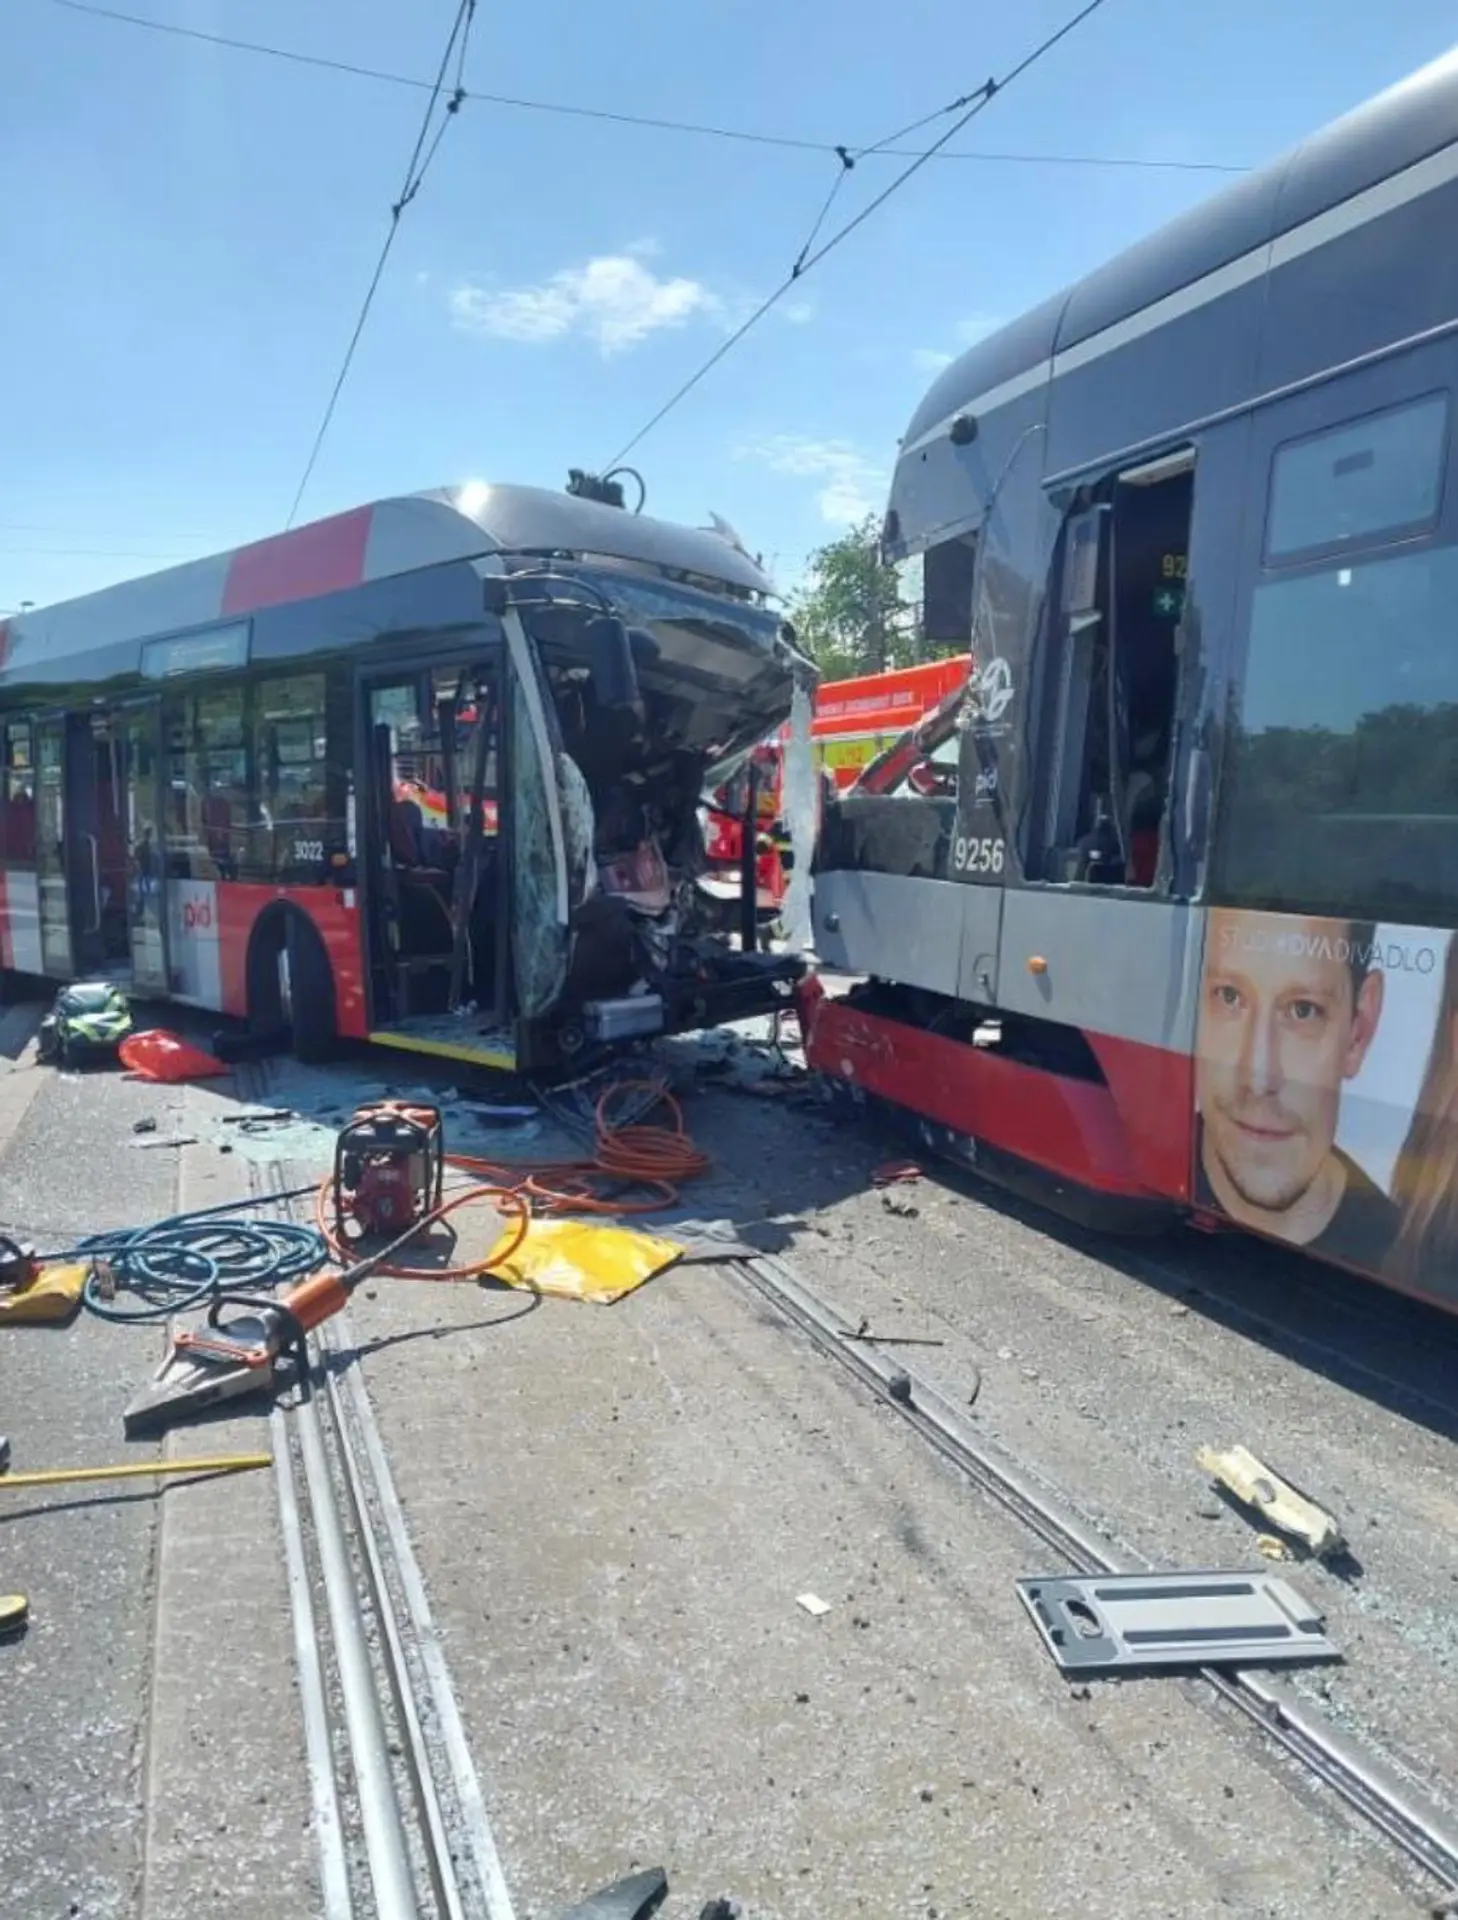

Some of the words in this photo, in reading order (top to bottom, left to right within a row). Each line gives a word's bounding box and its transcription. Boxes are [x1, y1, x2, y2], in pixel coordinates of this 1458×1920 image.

[294, 841, 324, 860] 3022
[954, 837, 1005, 874] 9256
[184, 892, 211, 935] pid
